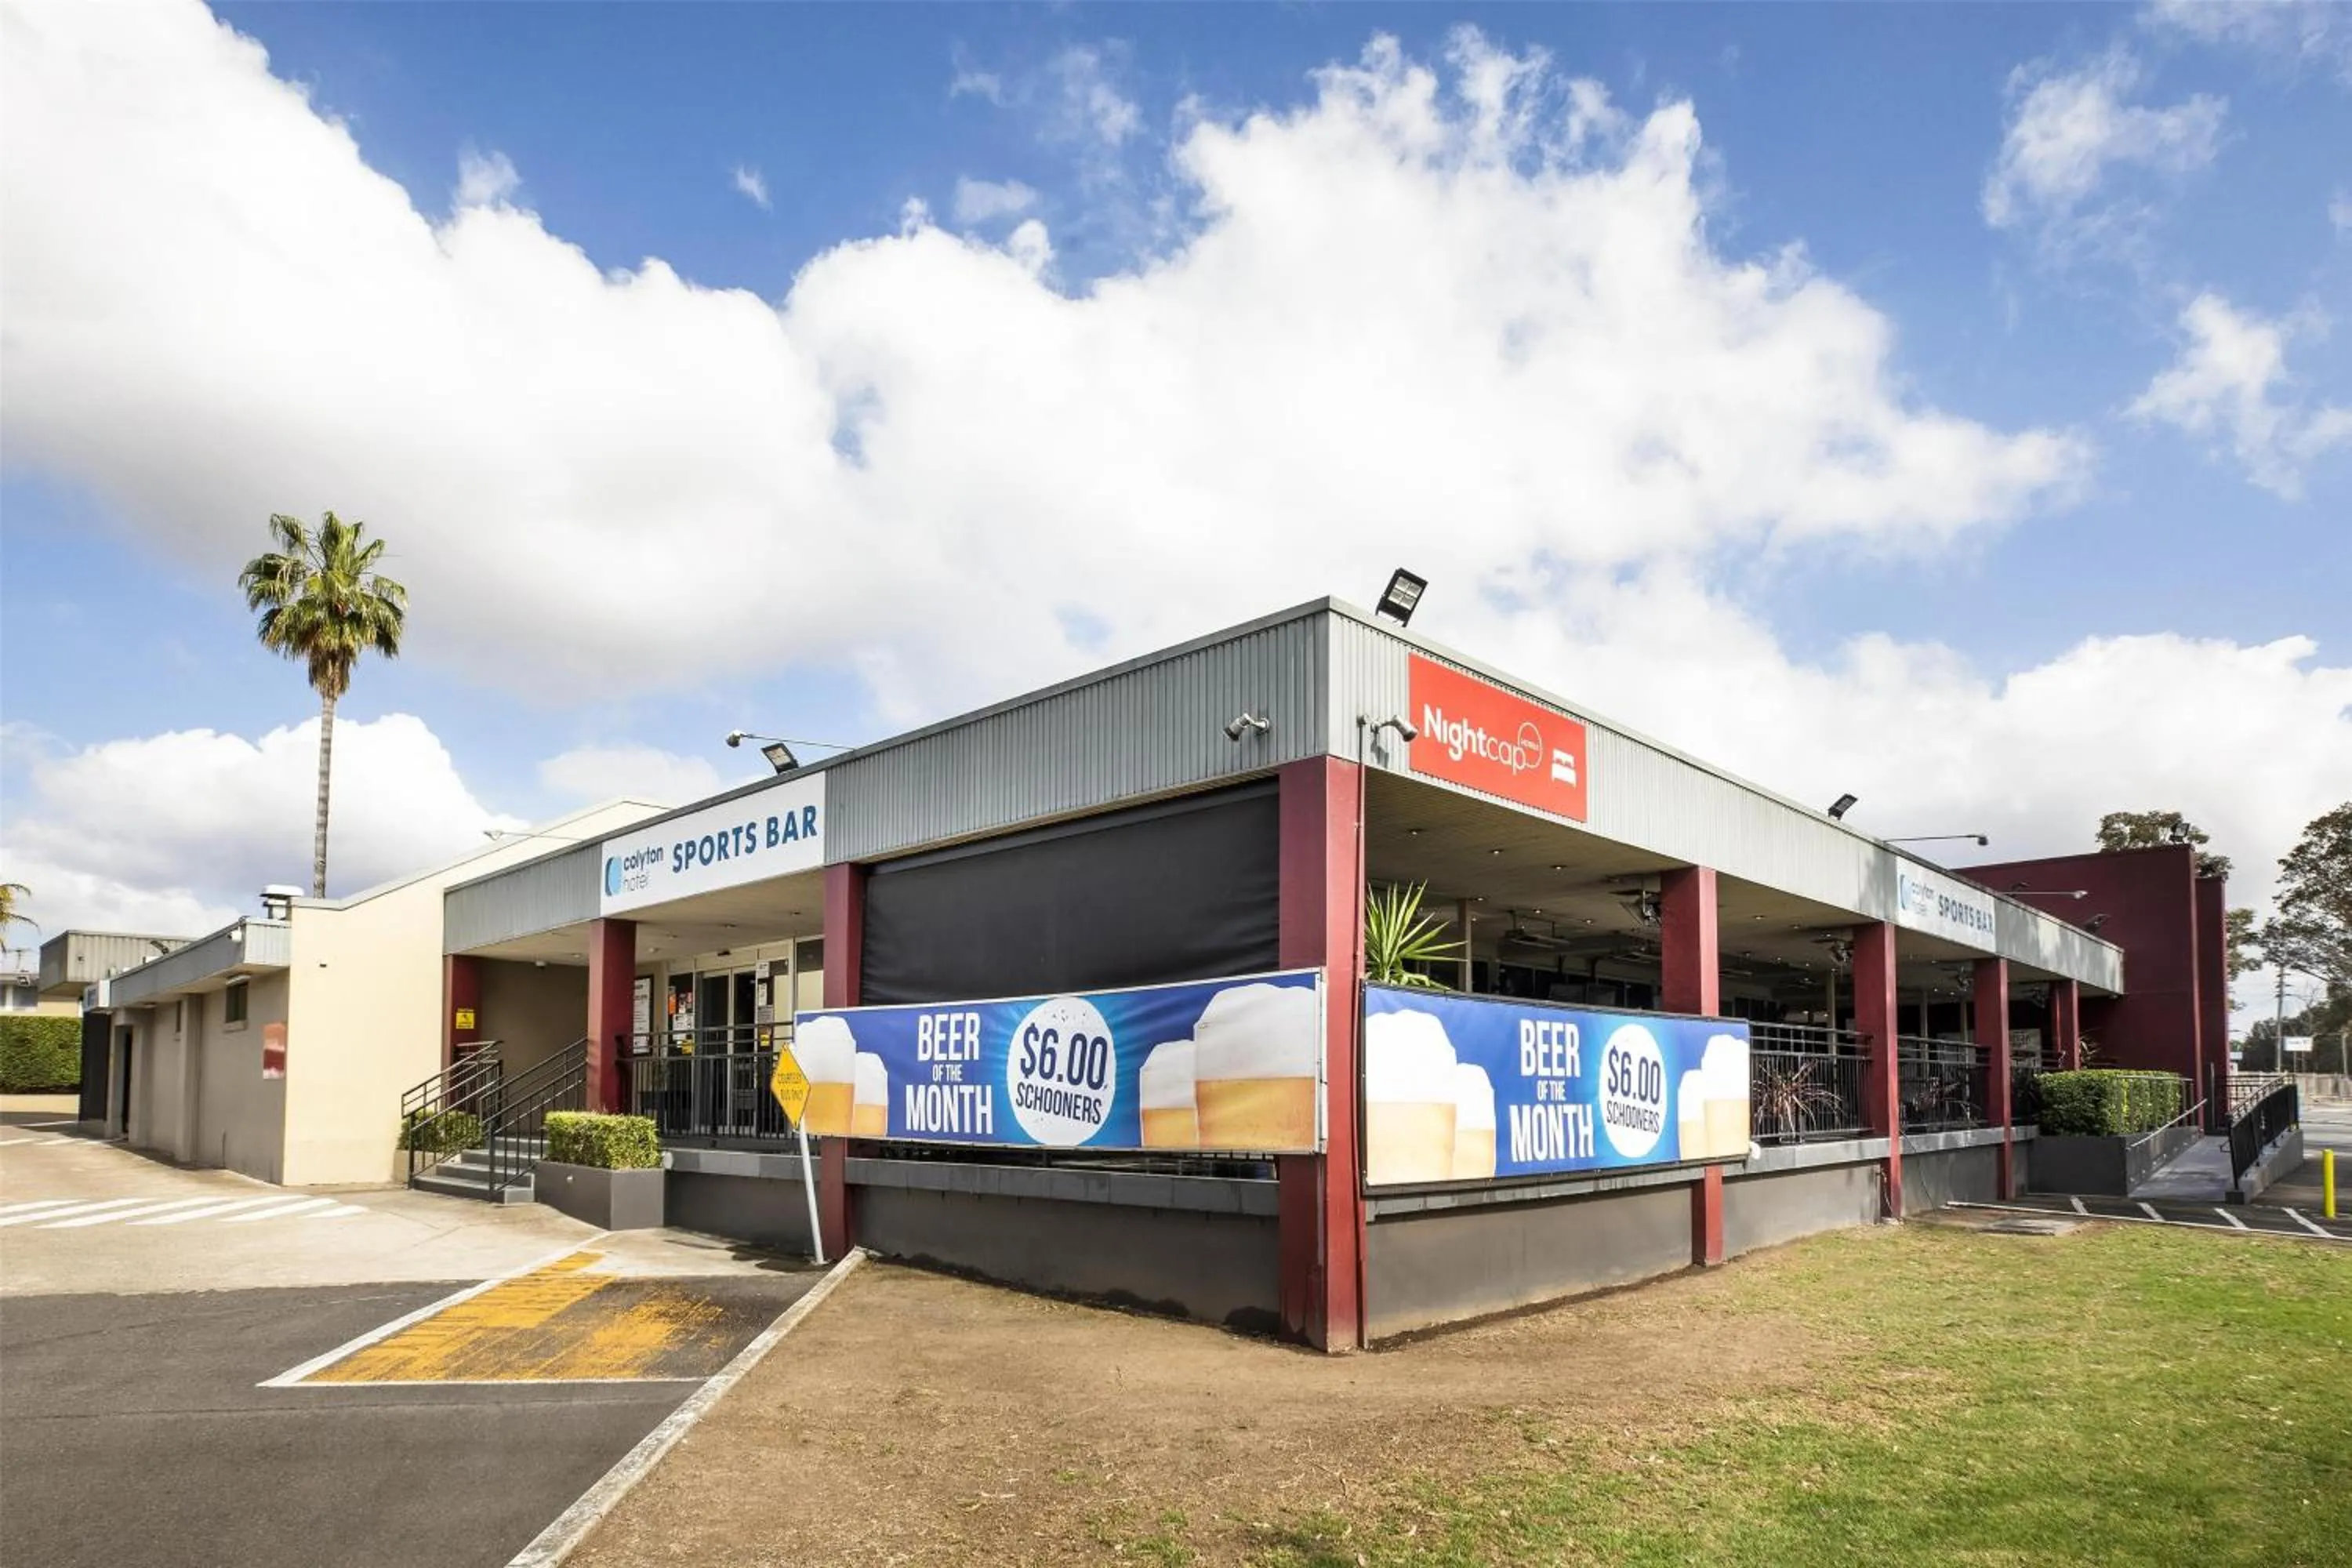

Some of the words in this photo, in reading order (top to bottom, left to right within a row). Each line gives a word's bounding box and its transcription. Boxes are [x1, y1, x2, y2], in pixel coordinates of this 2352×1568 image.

[1424, 703, 1526, 776] Nightcap
[623, 846, 664, 872] colyton
[672, 822, 757, 874] SPORTS
[766, 805, 818, 849] BAR
[1939, 894, 1974, 928] SPORTS
[1976, 909, 1994, 935] BAR
[917, 1012, 981, 1062] BEER
[1020, 1022, 1109, 1091] $6.00
[1519, 1019, 1581, 1079] BEER
[932, 1064, 946, 1083] OF
[946, 1064, 963, 1083] THE
[1537, 1080, 1549, 1102] OF
[1548, 1080, 1566, 1102] THE
[1608, 1045, 1661, 1105] $6.00
[906, 1084, 993, 1134] MONTH
[1016, 1081, 1102, 1125] SCHOONERS
[1606, 1100, 1661, 1134] SCHOONERS
[1509, 1104, 1596, 1163] MONTH
